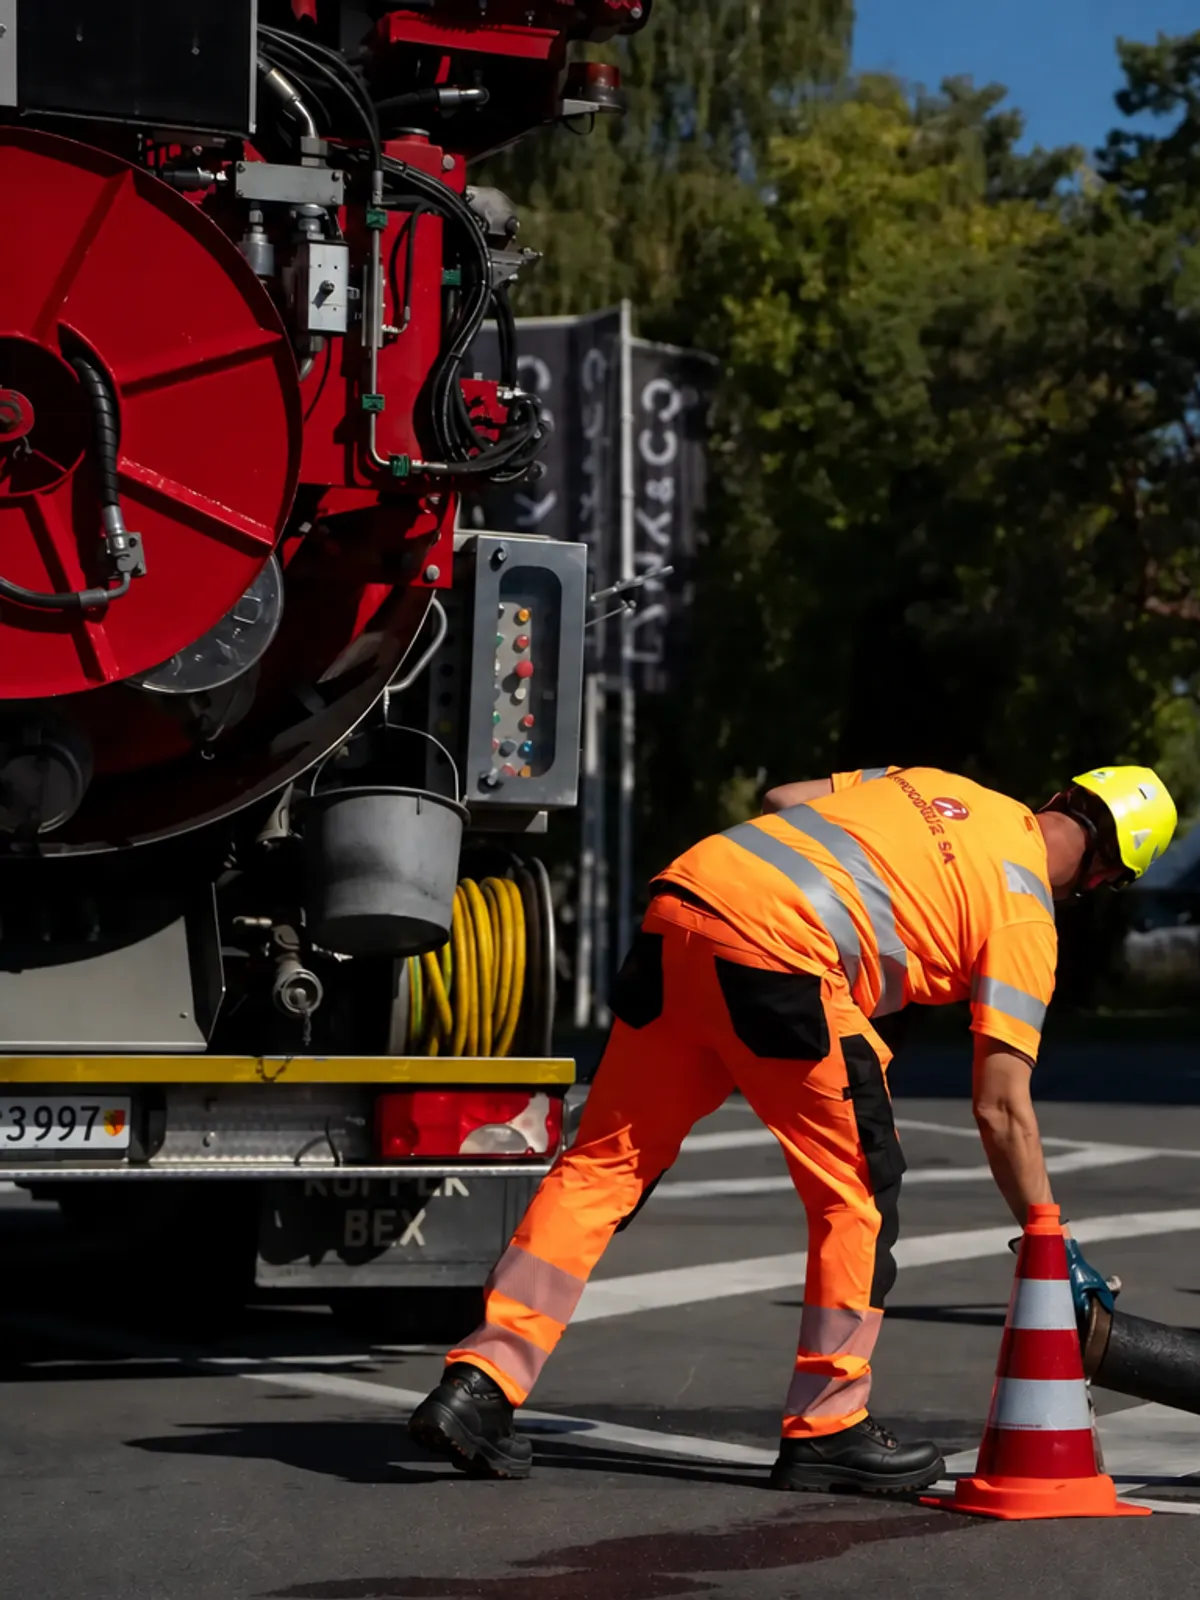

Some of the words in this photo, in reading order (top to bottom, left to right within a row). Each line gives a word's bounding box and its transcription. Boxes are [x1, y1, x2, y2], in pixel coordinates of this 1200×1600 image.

[938, 840, 955, 864] SA
[0, 1104, 101, 1142] 3997
[343, 1207, 427, 1247] BEX
